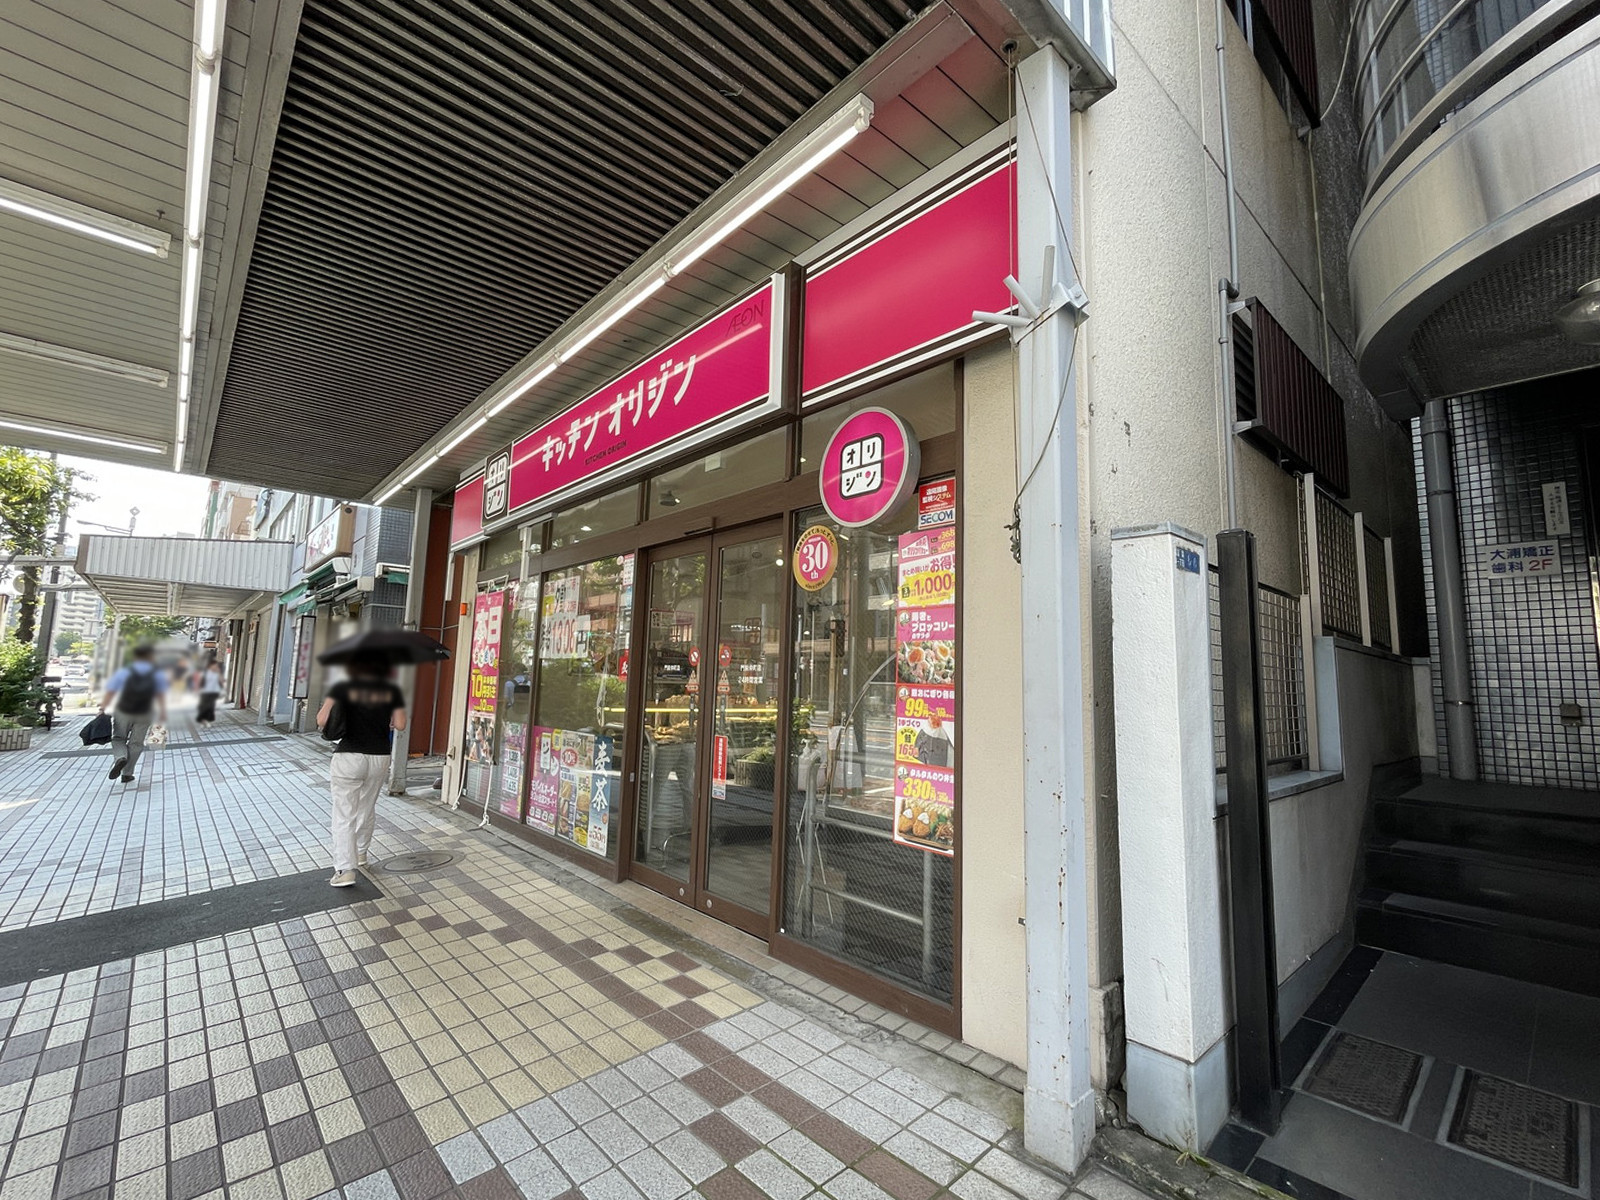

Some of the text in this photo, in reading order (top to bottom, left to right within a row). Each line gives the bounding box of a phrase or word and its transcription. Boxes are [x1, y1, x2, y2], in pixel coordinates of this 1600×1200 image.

[541, 355, 697, 472] キッチン オリジン
[585, 440, 627, 466] KITCHEN ORIGIN
[847, 442, 875, 465] オリ
[921, 510, 952, 525] SECOM
[802, 541, 828, 573] 30
[1491, 559, 1553, 574] 歯科 2F
[914, 573, 952, 596] 1,000
[911, 621, 955, 632] ブロッコリー
[591, 741, 611, 811] 麦茶
